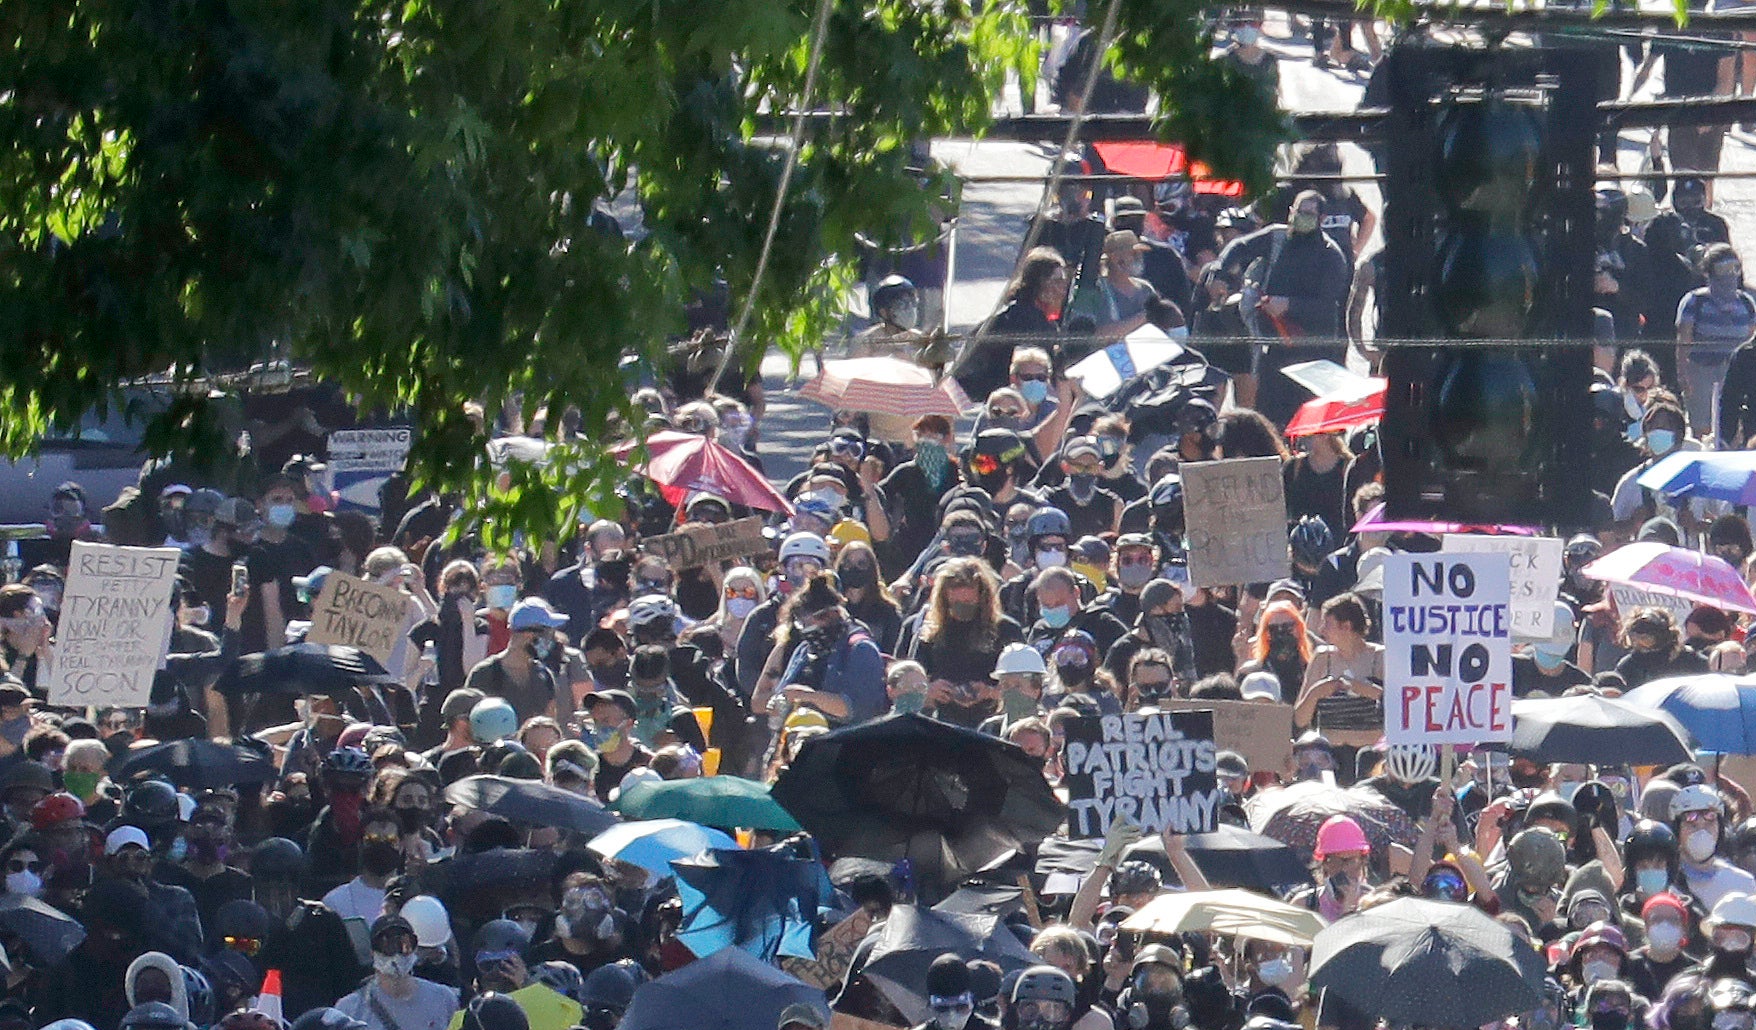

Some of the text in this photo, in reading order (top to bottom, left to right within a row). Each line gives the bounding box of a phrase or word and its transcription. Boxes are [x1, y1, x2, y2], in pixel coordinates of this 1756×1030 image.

[80, 553, 175, 578] RESIST
[1411, 562, 1475, 598] NO
[66, 595, 164, 618] TYRANNY
[1390, 604, 1508, 638] JUSTICE
[324, 608, 394, 651] TAYLOR
[1411, 643, 1490, 683] NO
[60, 671, 139, 697] SOON
[1402, 684, 1506, 733] PEACE
[1100, 714, 1184, 744] REAL
[1067, 739, 1216, 776] PATRIOTS
[1093, 769, 1192, 799] FIGHT
[1068, 788, 1220, 836] TYRANNY
